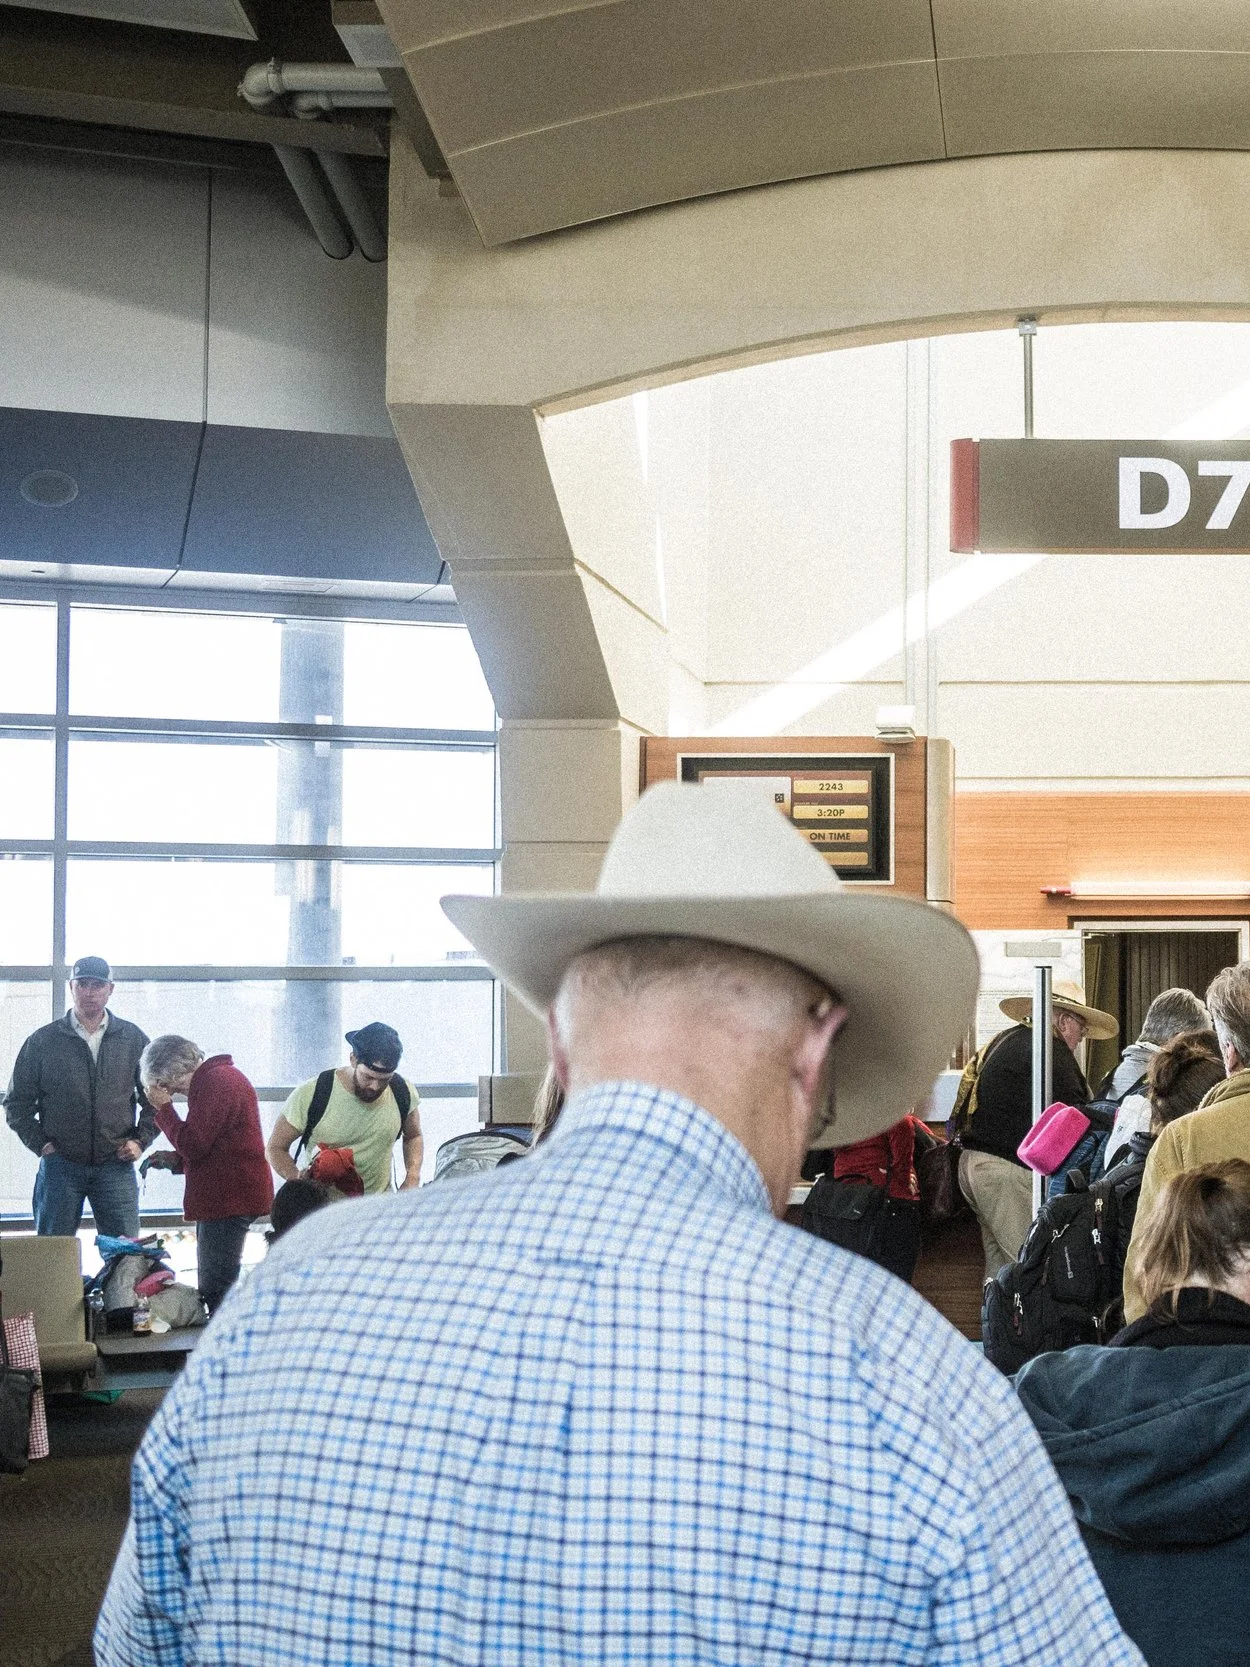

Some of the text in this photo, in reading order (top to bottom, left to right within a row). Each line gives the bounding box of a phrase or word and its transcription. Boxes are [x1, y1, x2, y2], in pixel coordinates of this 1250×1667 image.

[818, 782, 844, 791] 2243
[816, 808, 845, 817] 3:20P
[809, 832, 851, 841] ON TIME
